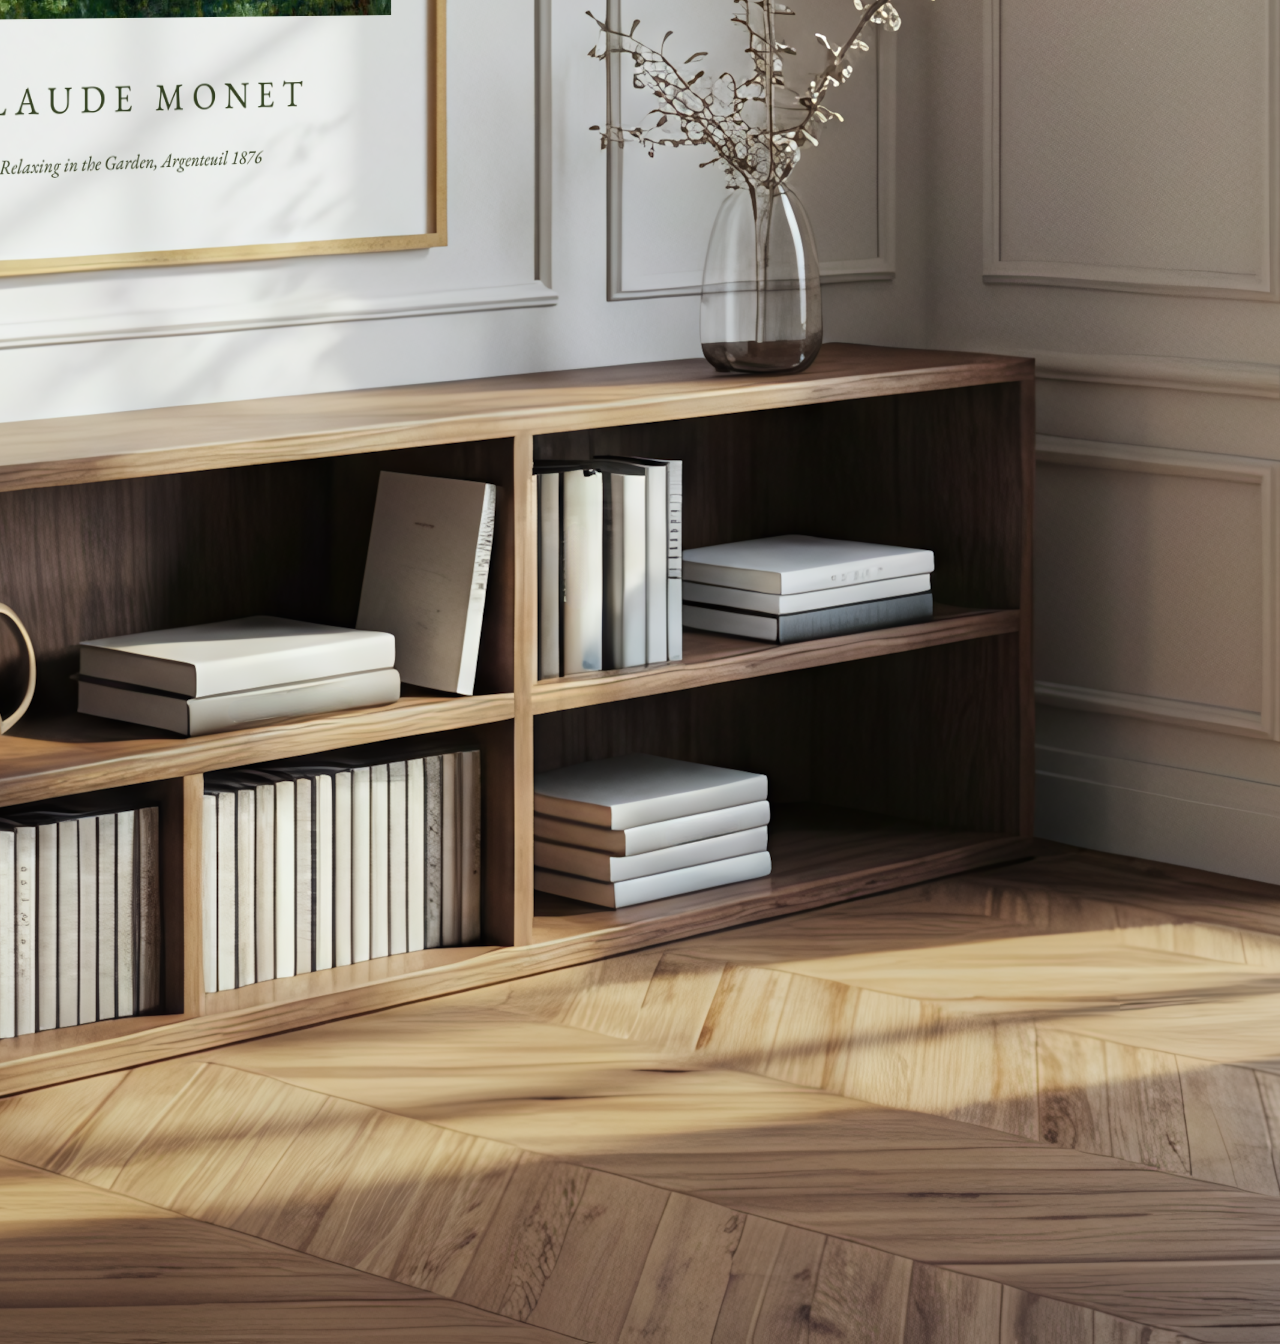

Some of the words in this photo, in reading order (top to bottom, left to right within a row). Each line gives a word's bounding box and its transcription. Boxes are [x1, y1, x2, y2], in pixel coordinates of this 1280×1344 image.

[155, 80, 304, 112] MONET
[63, 157, 78, 173] in
[81, 155, 102, 172] the
[105, 153, 158, 171] Garden,
[159, 149, 229, 174] Argenteuil
[231, 150, 264, 165] 1876
